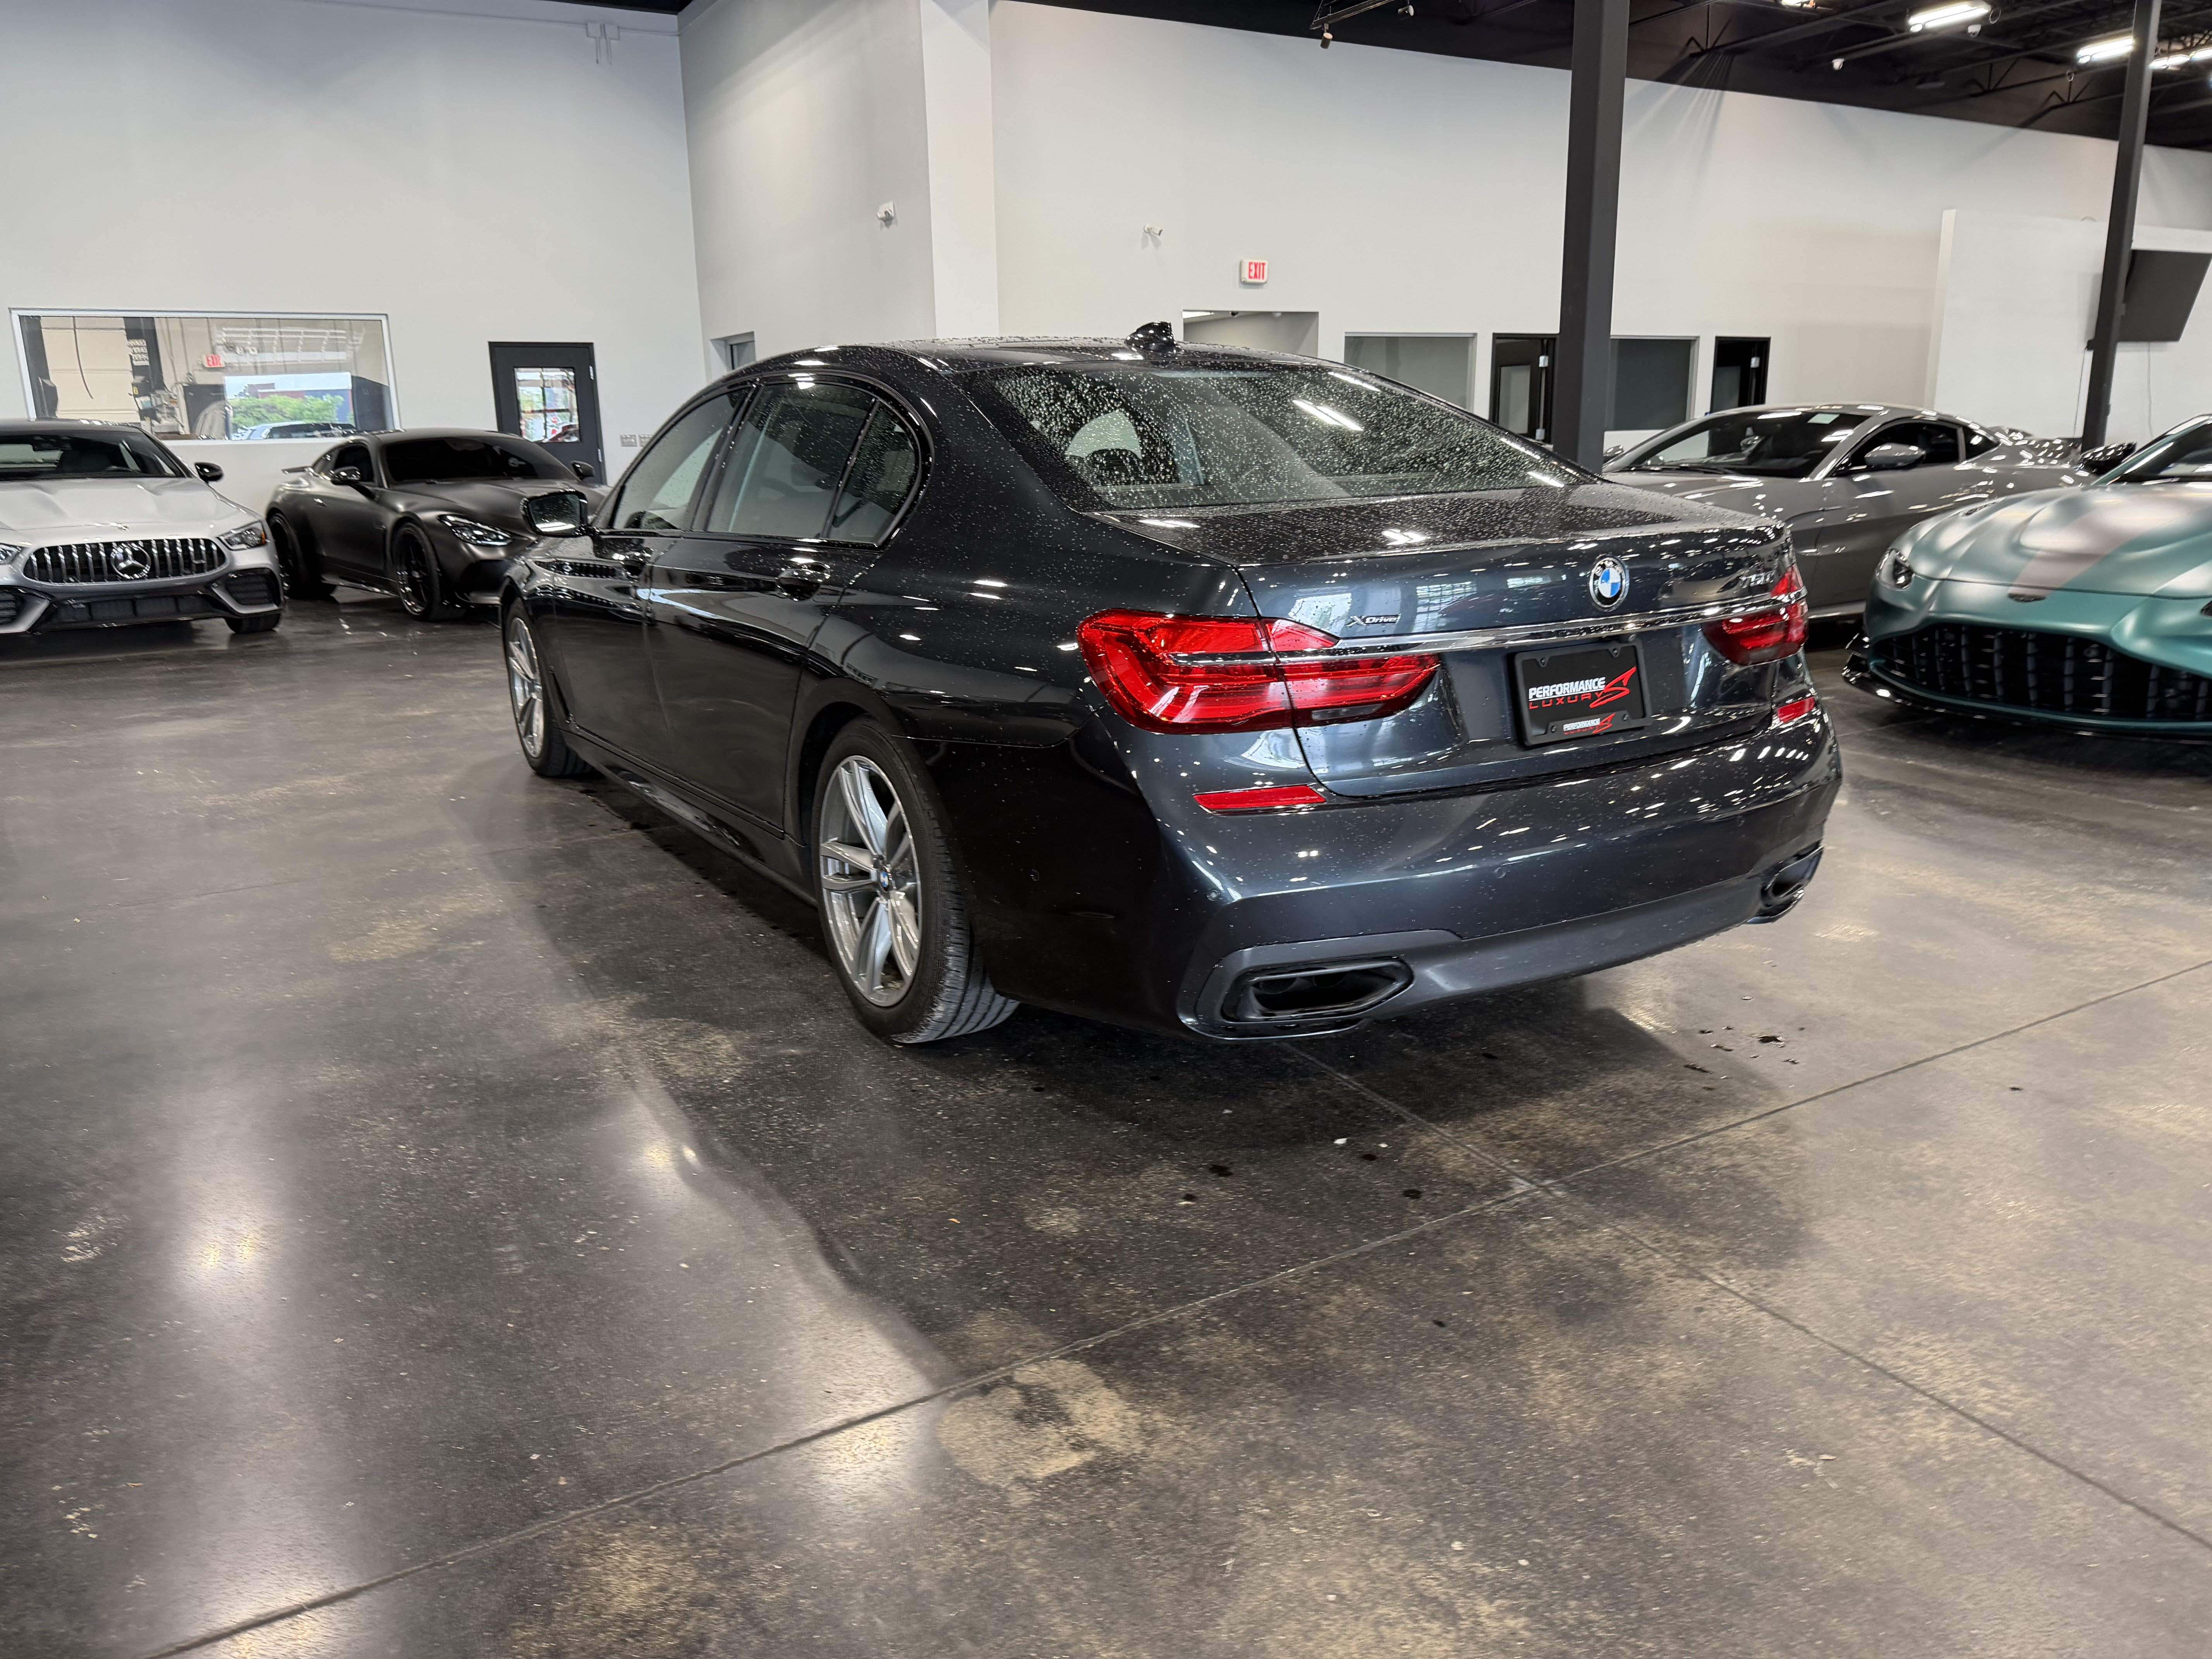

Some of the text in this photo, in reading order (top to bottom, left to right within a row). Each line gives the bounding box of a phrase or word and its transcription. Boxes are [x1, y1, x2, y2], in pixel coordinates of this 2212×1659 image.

[1249, 262, 1266, 280] EXIT
[1529, 677, 1606, 699] PERFORMANCE
[1529, 691, 1604, 709] LUXURY
